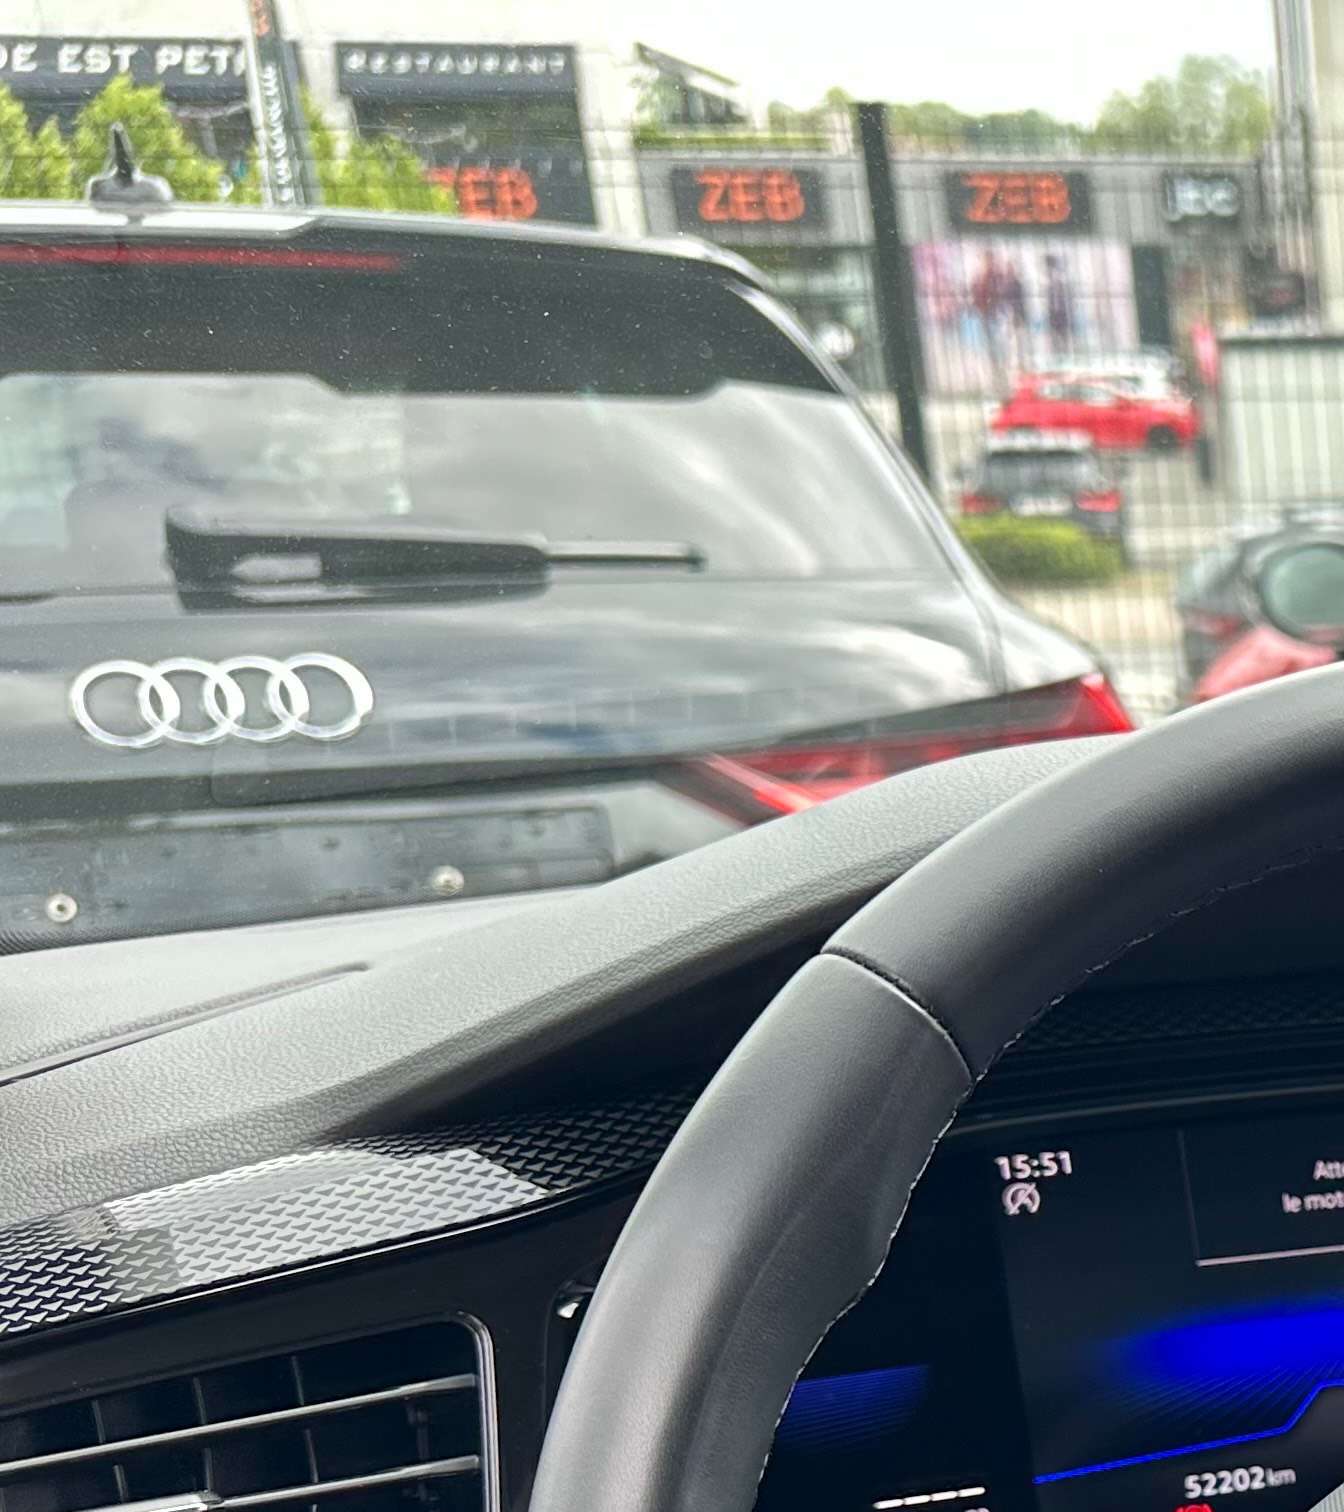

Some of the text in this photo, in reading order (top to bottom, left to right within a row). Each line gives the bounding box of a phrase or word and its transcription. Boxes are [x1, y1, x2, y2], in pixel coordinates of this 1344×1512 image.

[58, 43, 140, 74] EST
[696, 168, 806, 222] ZEB
[962, 170, 1072, 224] ZEB
[995, 1150, 1074, 1182] 15:51
[1281, 1192, 1302, 1213] le
